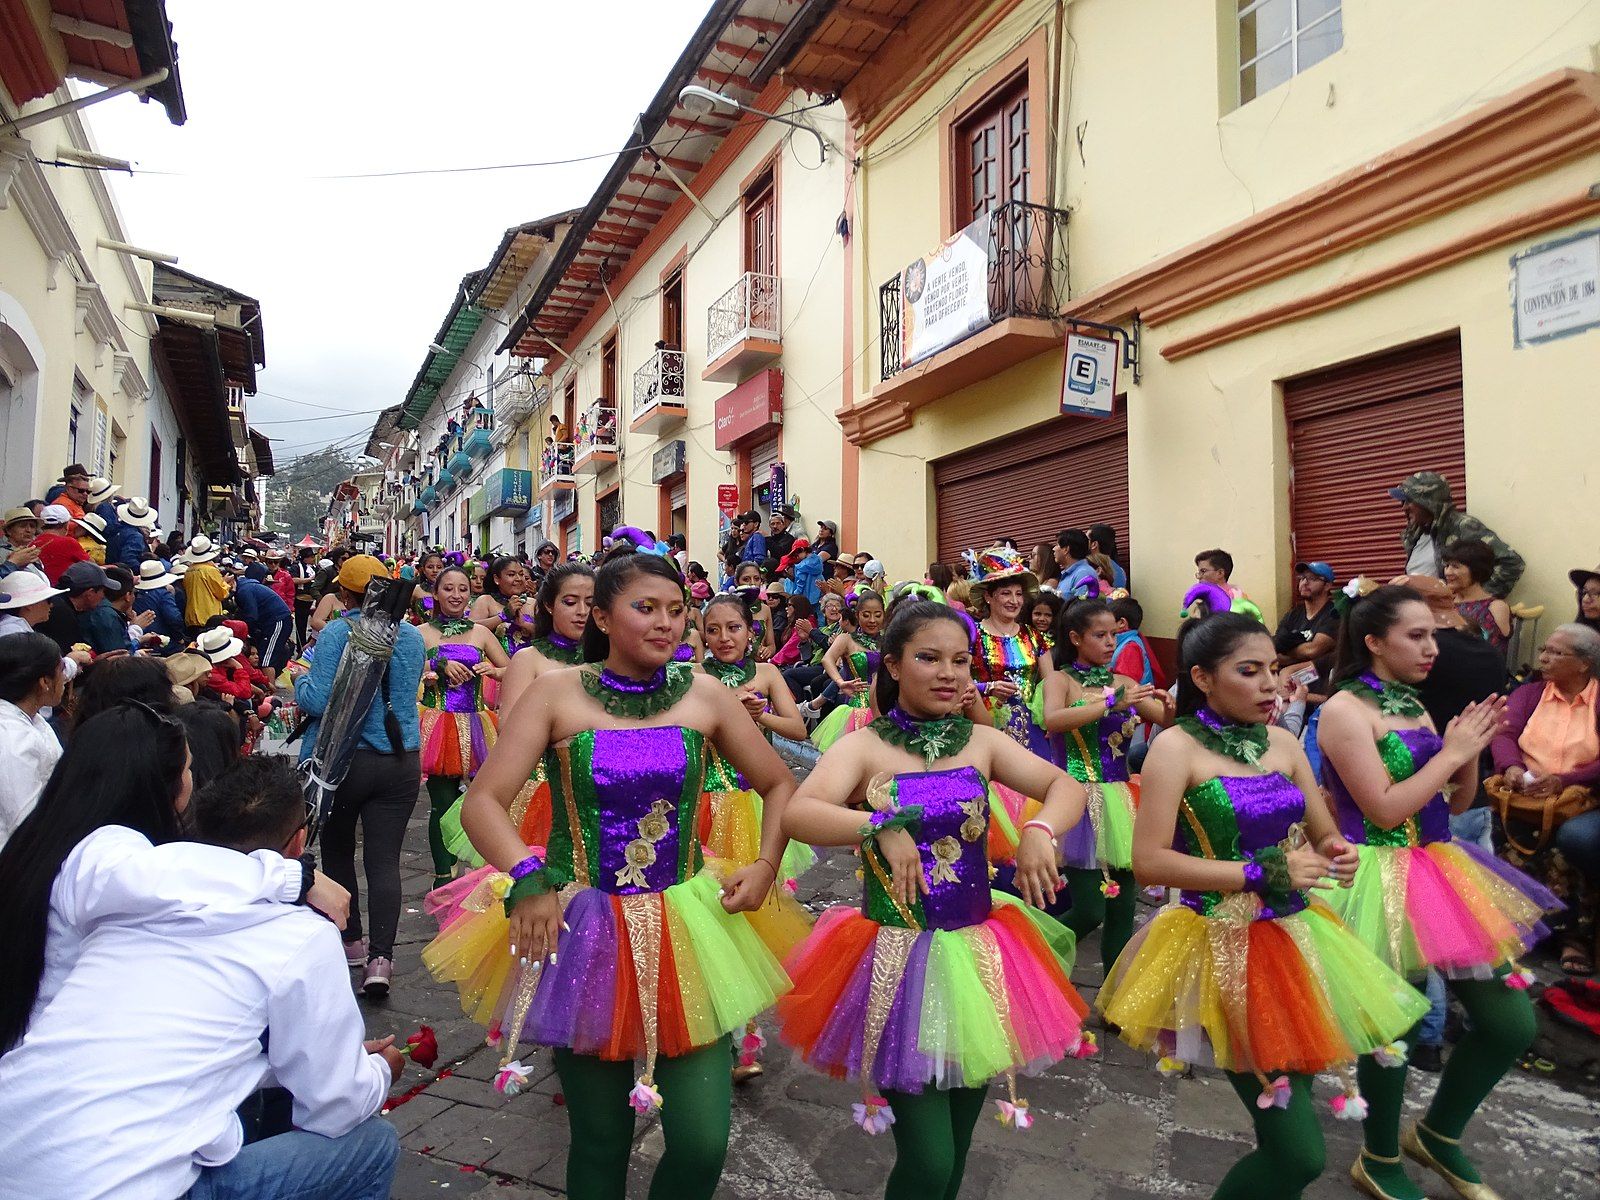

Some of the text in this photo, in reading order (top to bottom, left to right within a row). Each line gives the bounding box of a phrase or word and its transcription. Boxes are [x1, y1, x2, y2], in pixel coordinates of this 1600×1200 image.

[932, 272, 947, 289] VERTE
[924, 288, 940, 305] VENGO
[941, 282, 950, 295] POR
[948, 283, 969, 302] FLORES
[1568, 283, 1579, 301] DE
[925, 313, 938, 328] PARA
[1076, 360, 1091, 379] E
[717, 414, 732, 430] Claro
